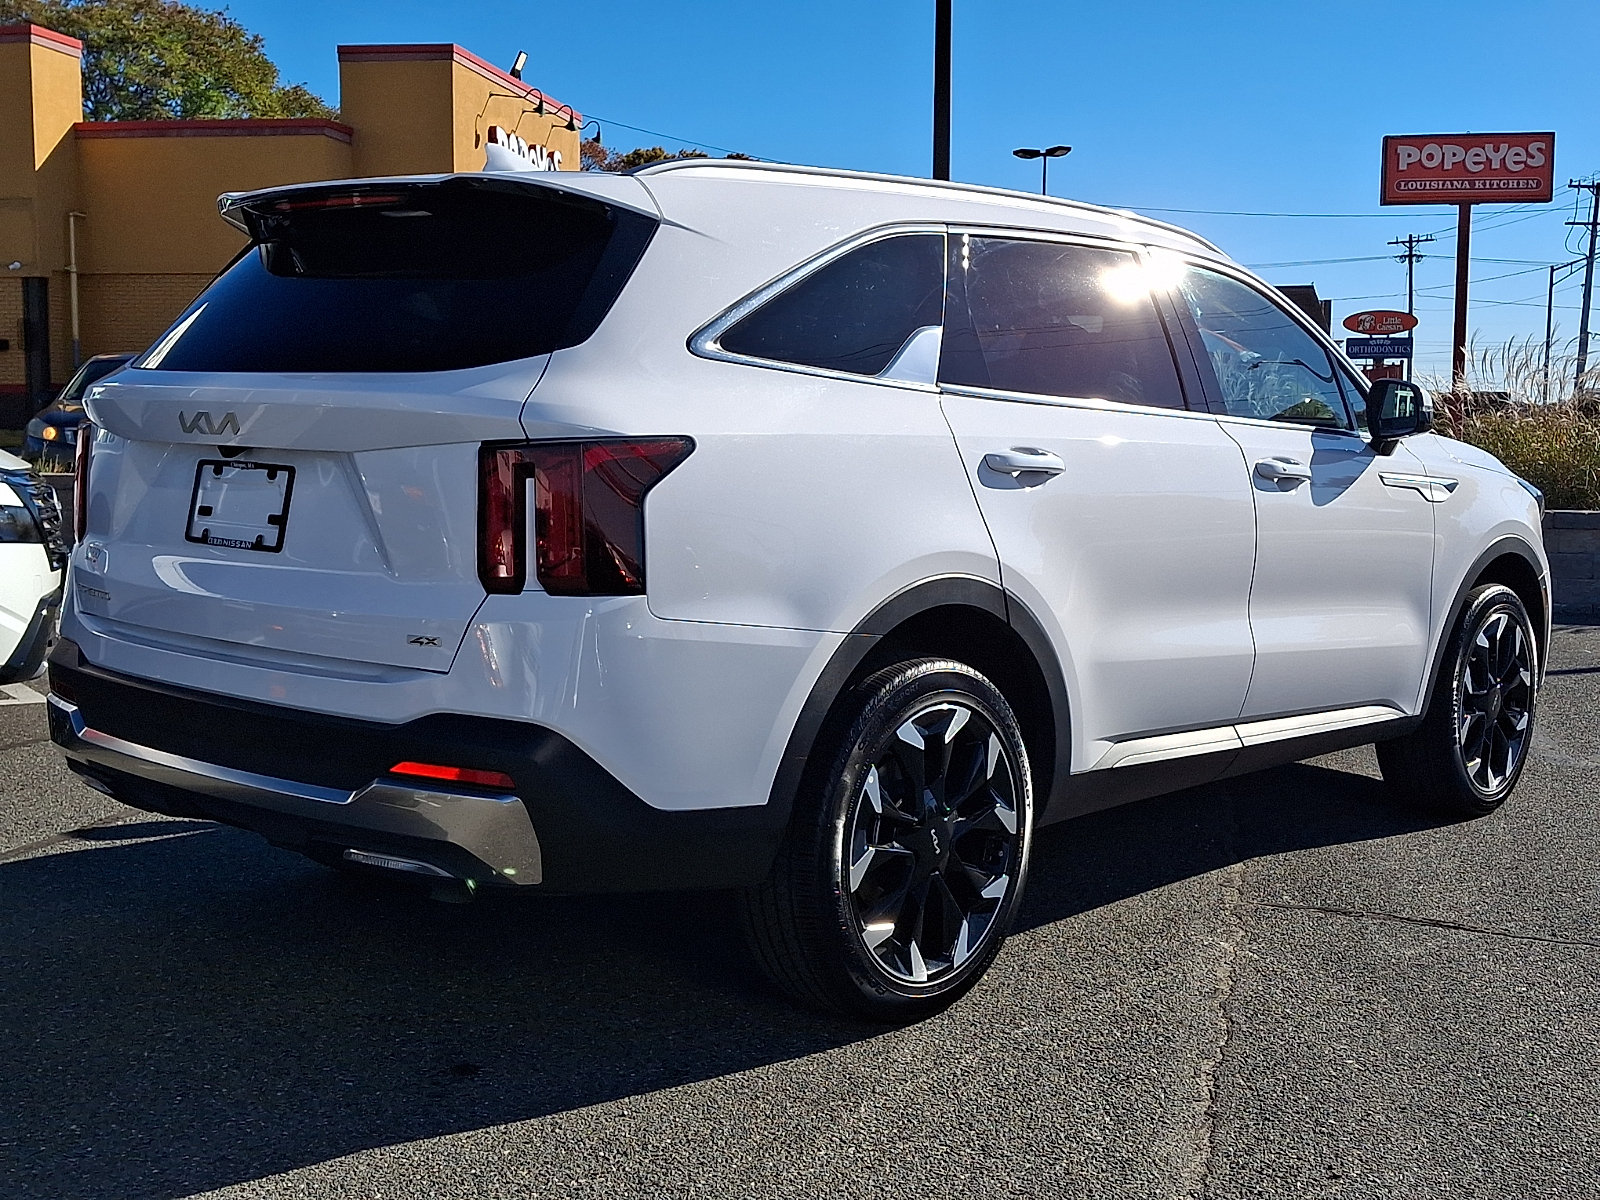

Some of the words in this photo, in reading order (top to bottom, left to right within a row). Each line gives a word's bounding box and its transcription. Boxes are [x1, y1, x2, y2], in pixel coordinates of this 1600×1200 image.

[1400, 180, 1470, 190] LOUISIANA
[1474, 179, 1538, 189] KITCHEN
[1383, 316, 1402, 325] Little
[1376, 323, 1404, 331] Caesars
[1348, 344, 1411, 354] ORTHODONTICS
[178, 410, 241, 435] KIA
[222, 539, 252, 549] NISSAN
